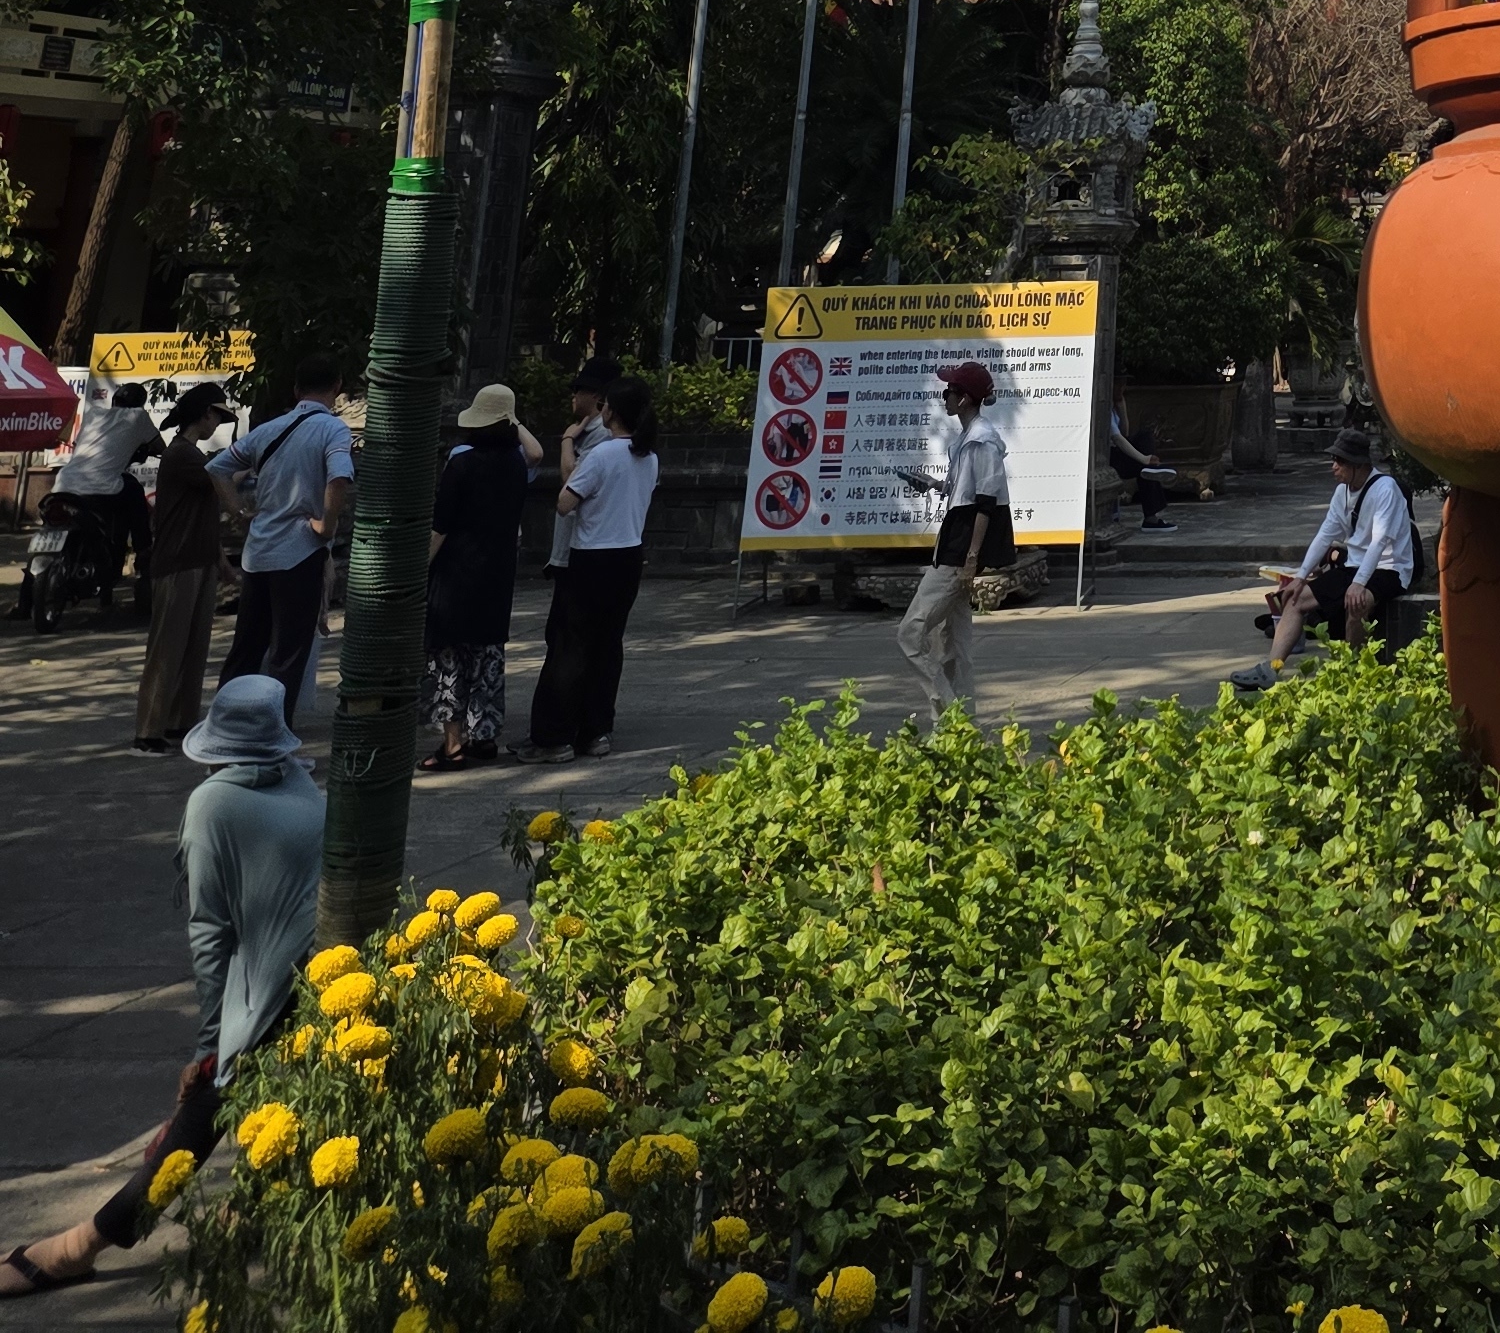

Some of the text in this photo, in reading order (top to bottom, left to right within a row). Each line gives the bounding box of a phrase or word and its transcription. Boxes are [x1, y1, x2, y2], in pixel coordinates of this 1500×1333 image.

[822, 289, 1085, 313] QUÝ KHÁCH KHI VÀO CHÙA VUI LÒNG MẶC
[855, 311, 1052, 333] TRANG PHỤC KÍN ĐÁO, LỊCH SỰ
[163, 339, 193, 349] KHÁH
[859, 350, 884, 361] when
[886, 349, 923, 362] entering
[924, 348, 938, 360] the
[941, 348, 974, 360] temple,
[976, 347, 1004, 359] visitor
[1006, 347, 1036, 358] should
[1038, 347, 1061, 357] wear
[858, 364, 885, 376] polite
[886, 364, 919, 376] clothes
[921, 363, 938, 374] that
[989, 361, 1008, 373] legs
[1010, 361, 1027, 372] and
[1029, 362, 1052, 372] arms
[856, 389, 911, 402] Соблюдайте
[1033, 387, 1081, 399] дресс-код
[0, 412, 63, 431] ximBike
[846, 486, 866, 500] 사찰
[869, 486, 888, 500] 입장
[890, 486, 900, 499] 시
[1013, 508, 1035, 521] ます
